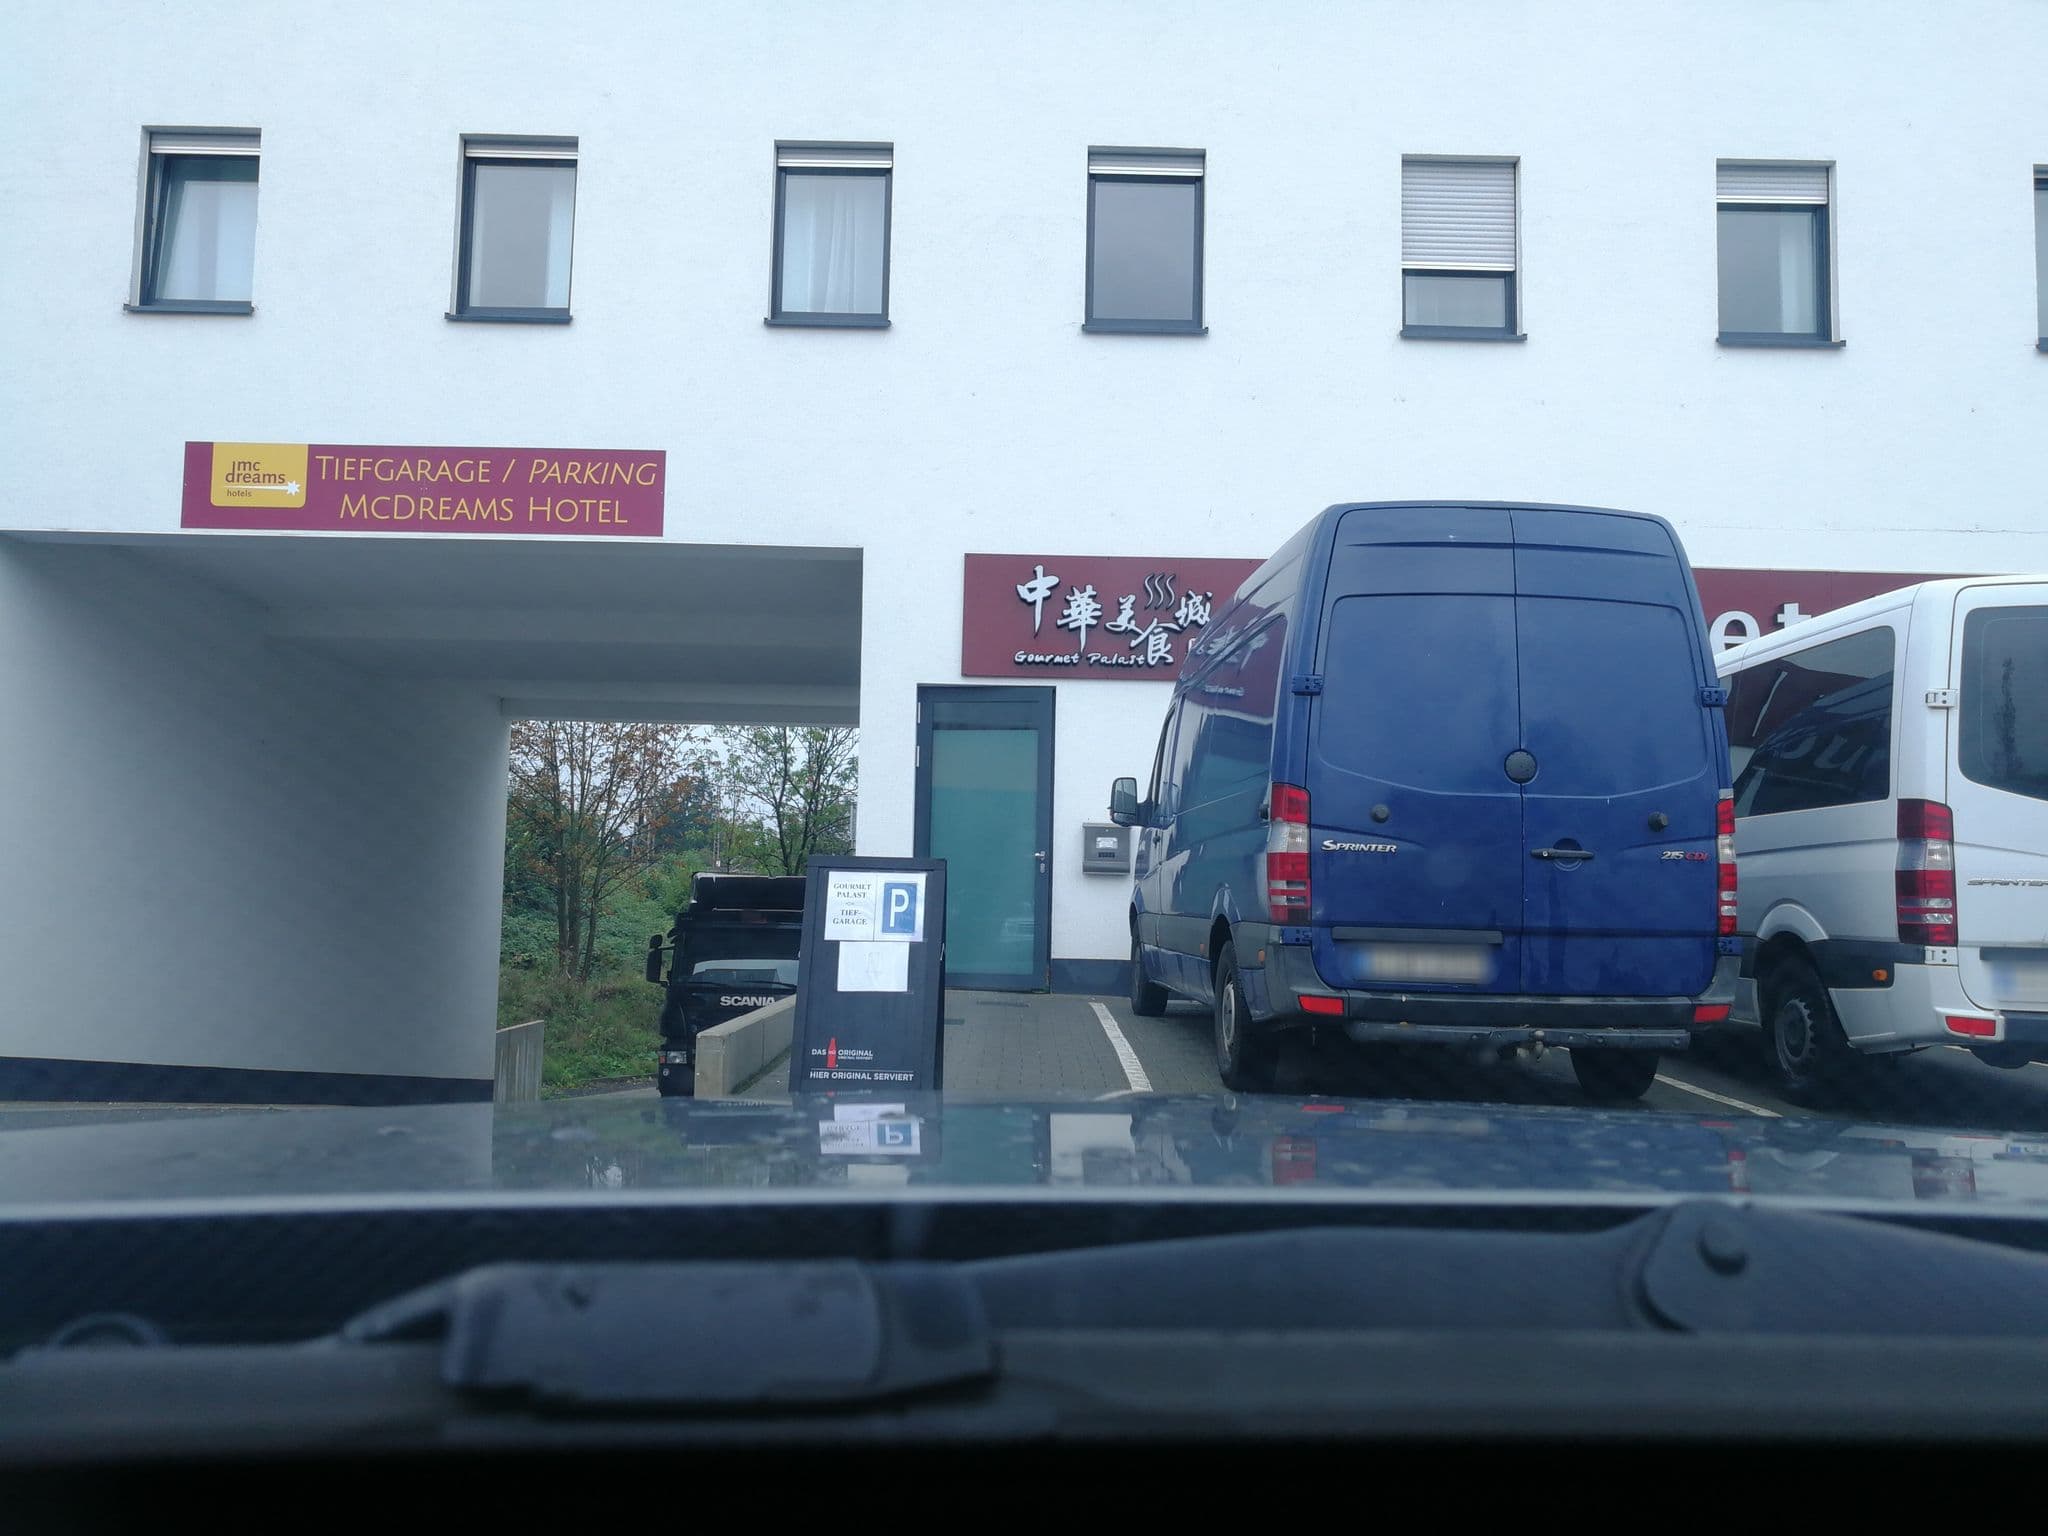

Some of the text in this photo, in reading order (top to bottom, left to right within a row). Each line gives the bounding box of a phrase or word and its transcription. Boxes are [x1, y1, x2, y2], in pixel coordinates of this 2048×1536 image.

[237, 460, 262, 472] mc
[315, 455, 492, 483] TIEFGARAGE
[528, 459, 658, 486] PARKING
[225, 461, 286, 484] dreams
[226, 489, 252, 498] hotels
[528, 496, 628, 523] HOTEL
[1014, 650, 1145, 665] Gourmet Palast
[1321, 839, 1397, 853] SPRINTER
[1661, 850, 1685, 860] 215
[836, 891, 867, 899] PALAST
[840, 909, 862, 917] TIEF-
[889, 888, 909, 928] P
[832, 917, 868, 926] GARAGE
[720, 995, 776, 1007] SCANIA
[811, 1048, 827, 1056] DAS
[837, 1049, 874, 1057] ORIGINAL
[809, 1071, 914, 1081] HIER ORIGINAL SERVIERT
